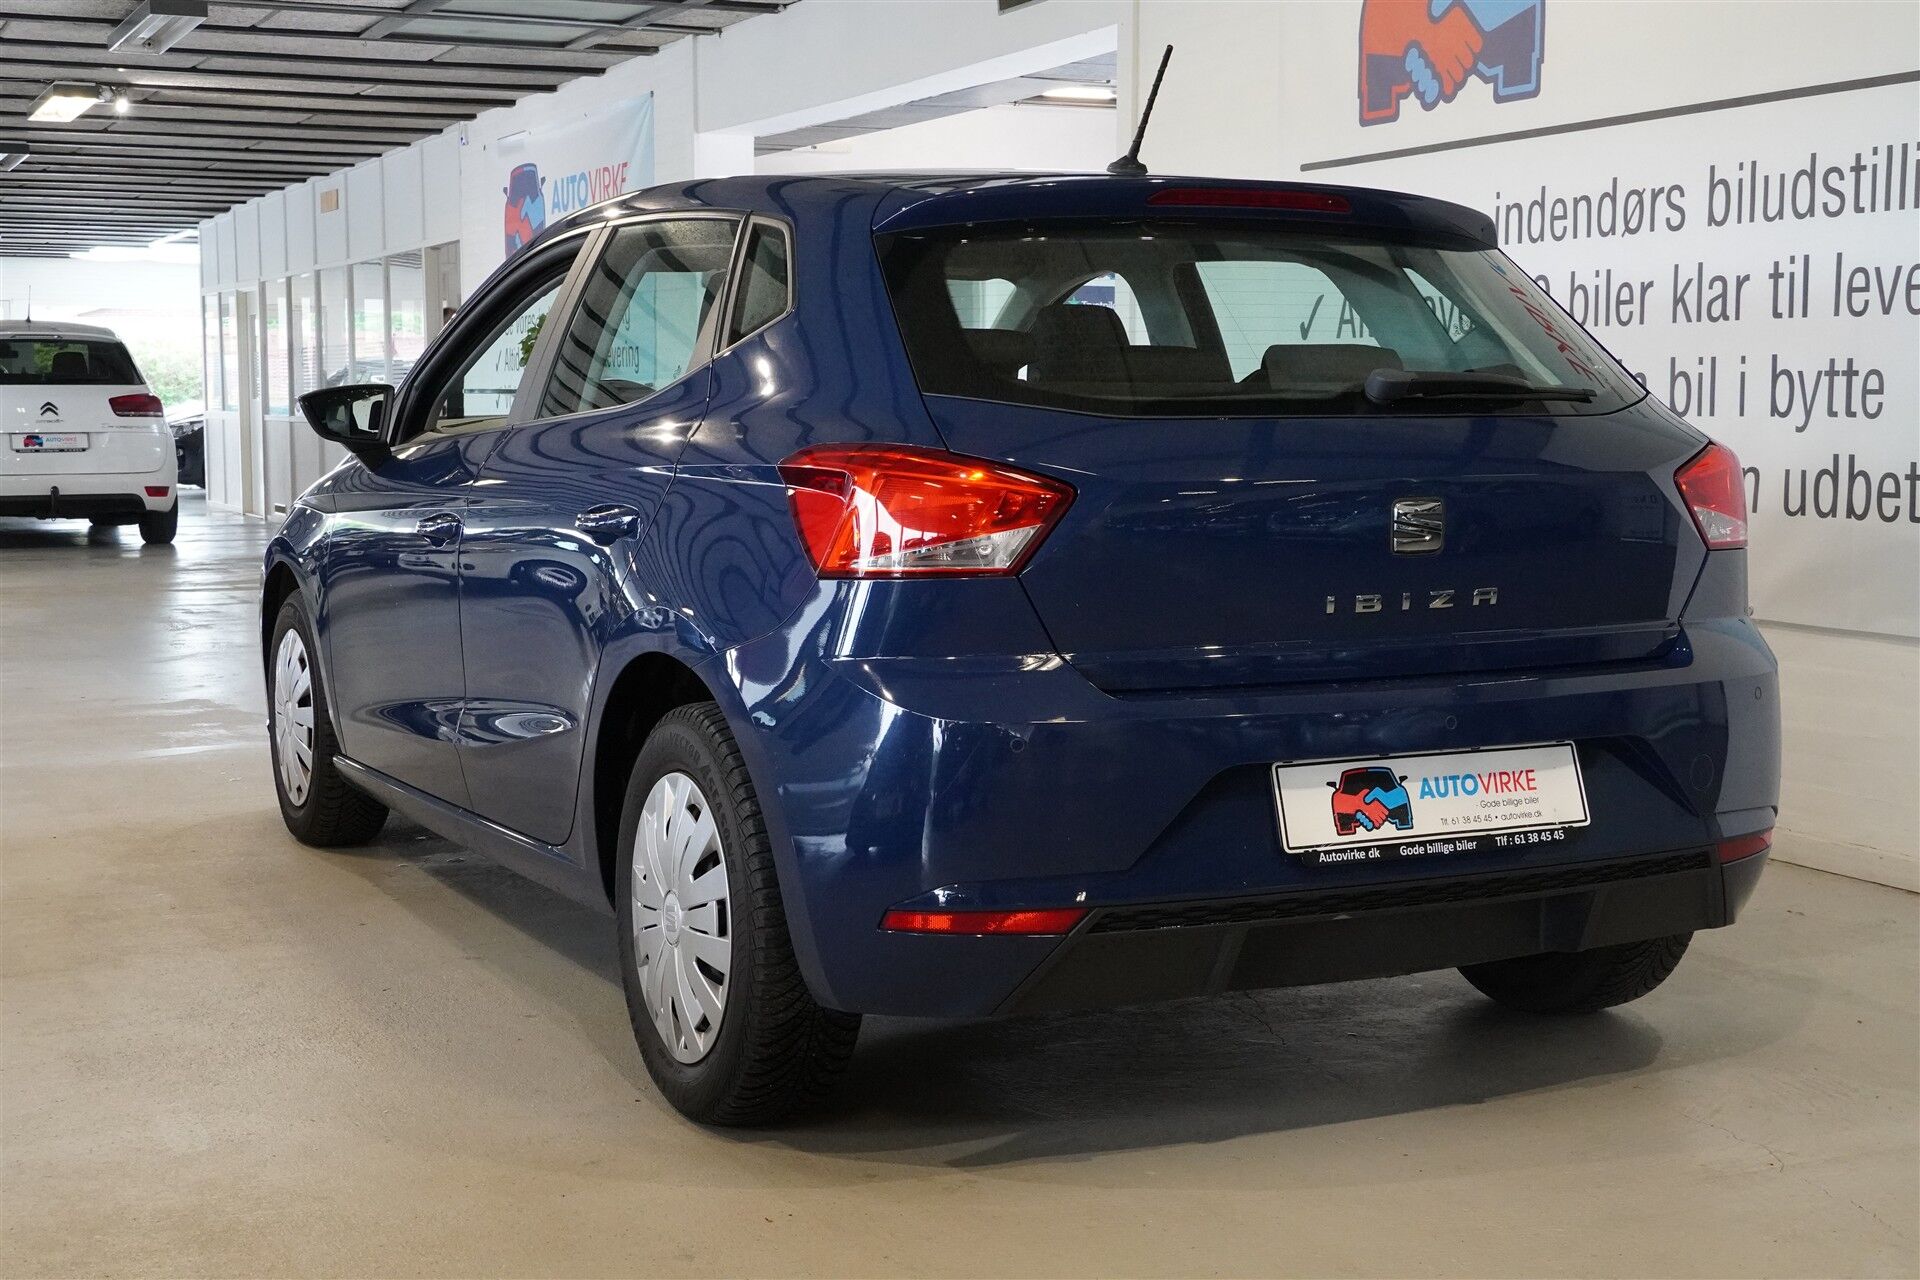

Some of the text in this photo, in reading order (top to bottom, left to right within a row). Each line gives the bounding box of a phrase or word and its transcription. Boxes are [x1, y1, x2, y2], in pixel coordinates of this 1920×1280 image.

[552, 161, 628, 214] AUTOVIRKE
[1494, 176, 1686, 246] indendørs
[1569, 269, 1654, 327] biler
[1672, 261, 1750, 324] klar
[1768, 254, 1810, 319] til
[1669, 356, 1717, 418] bil
[1739, 355, 1747, 417] i
[1770, 354, 1885, 433] bytte
[1419, 769, 1537, 800] AUTOVIRKE
[1480, 800, 1501, 809] Gode
[1502, 797, 1523, 808] billige
[1524, 796, 1540, 805] biler
[1451, 817, 1460, 825] 61
[1462, 815, 1471, 824] 38
[1473, 814, 1482, 823] 45
[1484, 814, 1493, 823] 45
[1501, 810, 1543, 821] autovirke.dk
[1318, 848, 1366, 863] Autovirke
[1368, 847, 1381, 859] dk
[1400, 845, 1425, 856] Gode
[1427, 841, 1454, 855] billige
[1456, 839, 1478, 851] biler
[1495, 835, 1508, 847] Tlf
[1514, 833, 1526, 844] 61
[1528, 832, 1539, 843] 38
[1540, 831, 1552, 842] 45
[1553, 829, 1565, 840] 45
